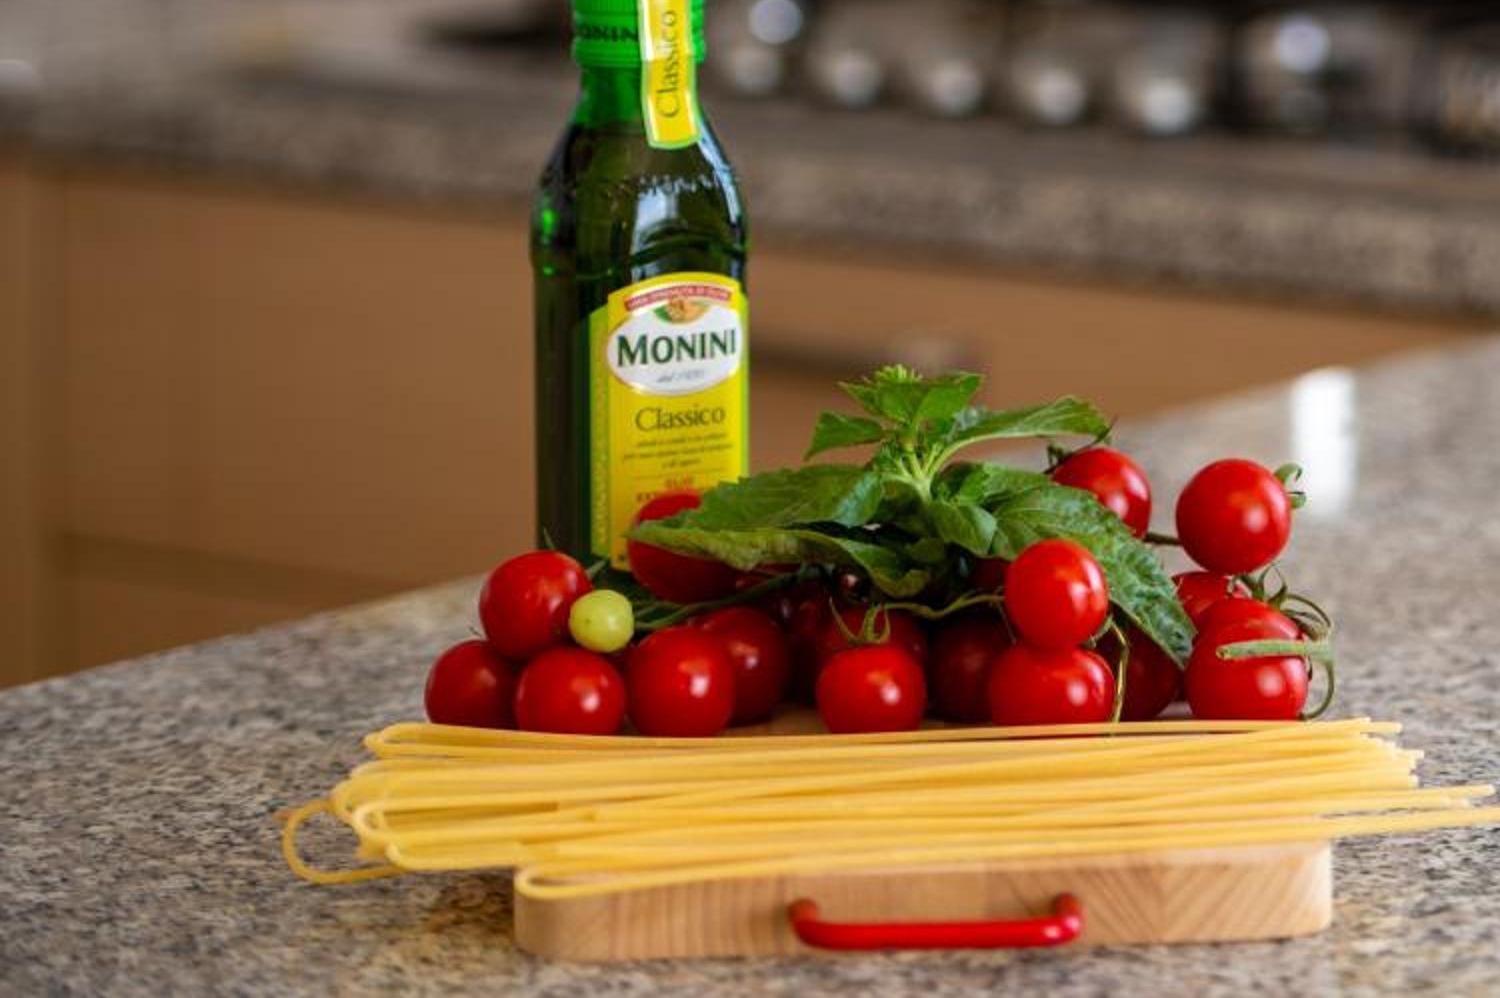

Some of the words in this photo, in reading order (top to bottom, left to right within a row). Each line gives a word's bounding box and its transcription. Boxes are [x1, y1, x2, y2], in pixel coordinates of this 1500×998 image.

[656, 10, 681, 118] Classico
[616, 329, 737, 368] MONINI
[635, 404, 726, 432] Classico
